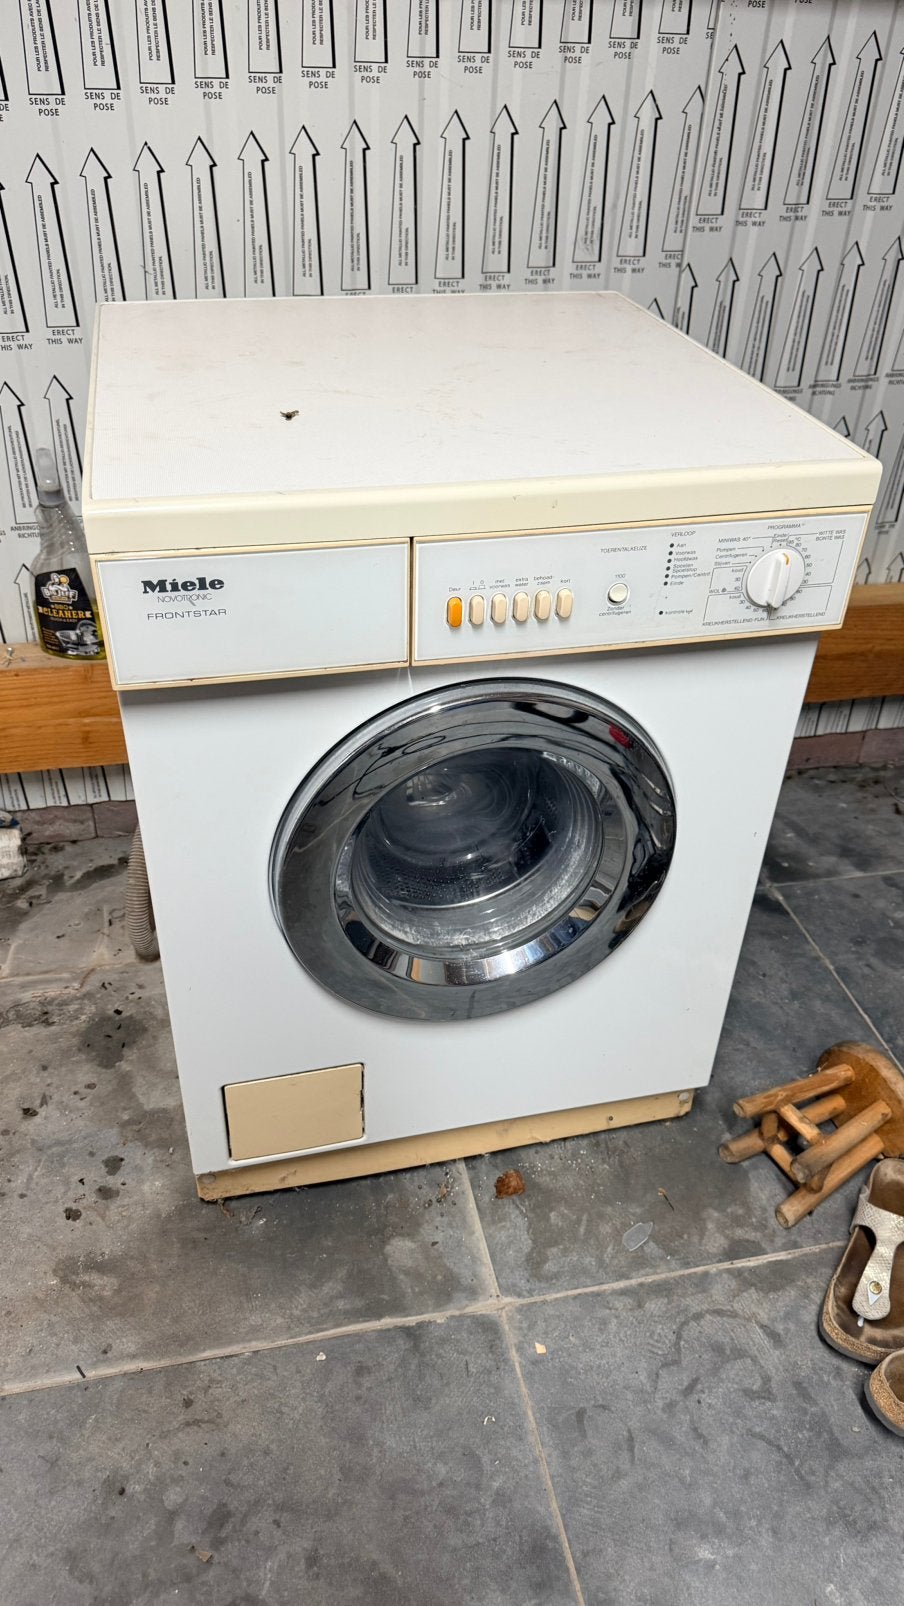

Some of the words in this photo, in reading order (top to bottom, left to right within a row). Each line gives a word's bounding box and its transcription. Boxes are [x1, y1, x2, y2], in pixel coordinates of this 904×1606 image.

[748, 0, 766, 8] POSE
[406, 60, 424, 68] SENS
[564, 56, 582, 64] POSE
[140, 86, 159, 94] SENS
[141, 577, 224, 594] Miele
[158, 592, 212, 606] NOVOTRONIC
[44, 608, 85, 618] CLEANER
[148, 608, 227, 620] FRONTSTAR
